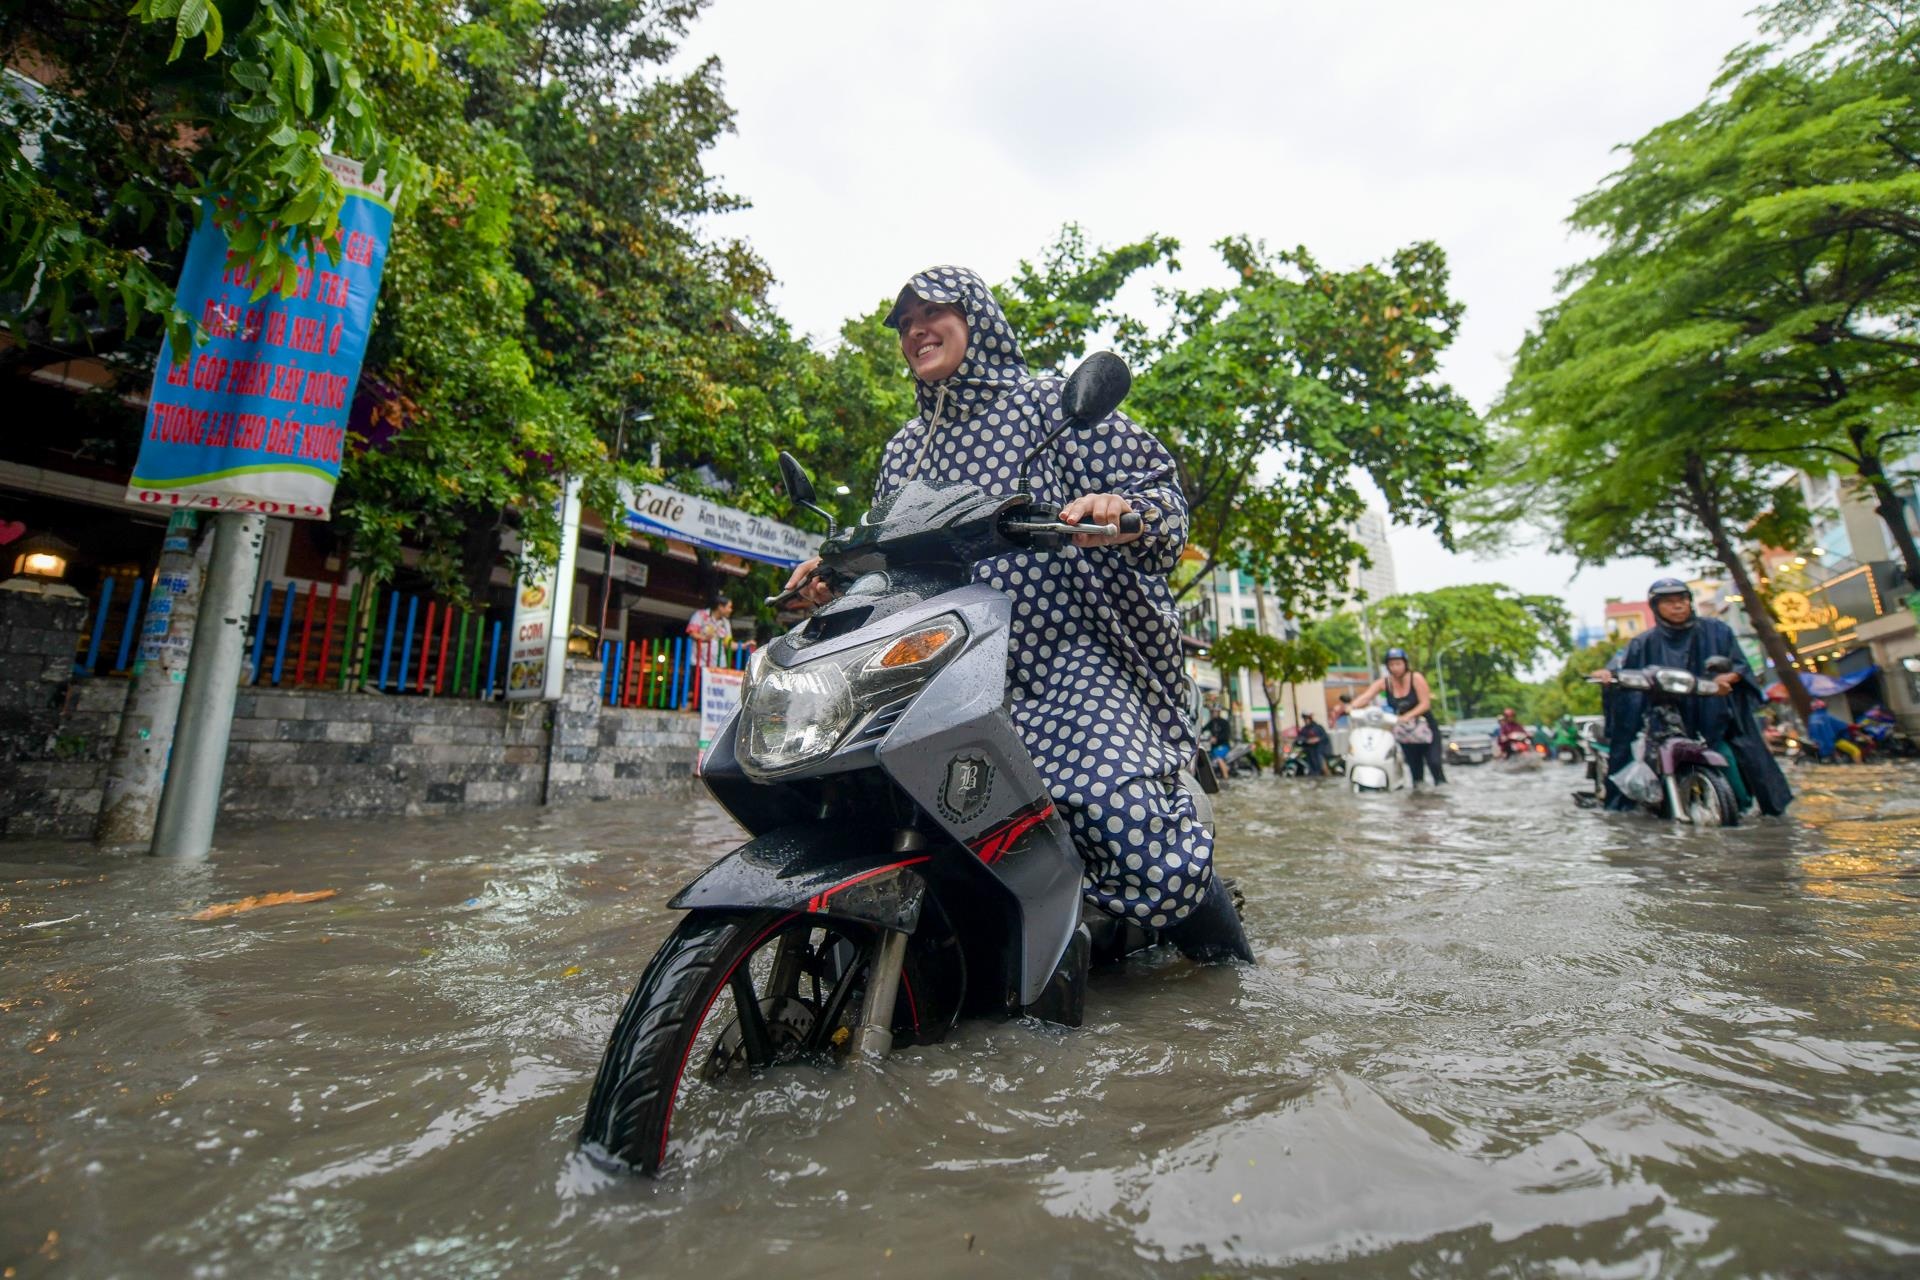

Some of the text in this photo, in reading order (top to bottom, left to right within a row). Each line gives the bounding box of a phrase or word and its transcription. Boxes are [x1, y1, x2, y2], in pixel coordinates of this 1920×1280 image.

[346, 231, 375, 267] GIA
[317, 271, 349, 308] TRA
[266, 306, 289, 346] VÀ
[289, 314, 327, 354] NHÀ
[193, 348, 228, 392] GÓP
[269, 358, 305, 402] XÂY
[206, 410, 234, 447] LAI
[233, 413, 266, 450] CHO
[139, 491, 324, 516] 01/4/2019
